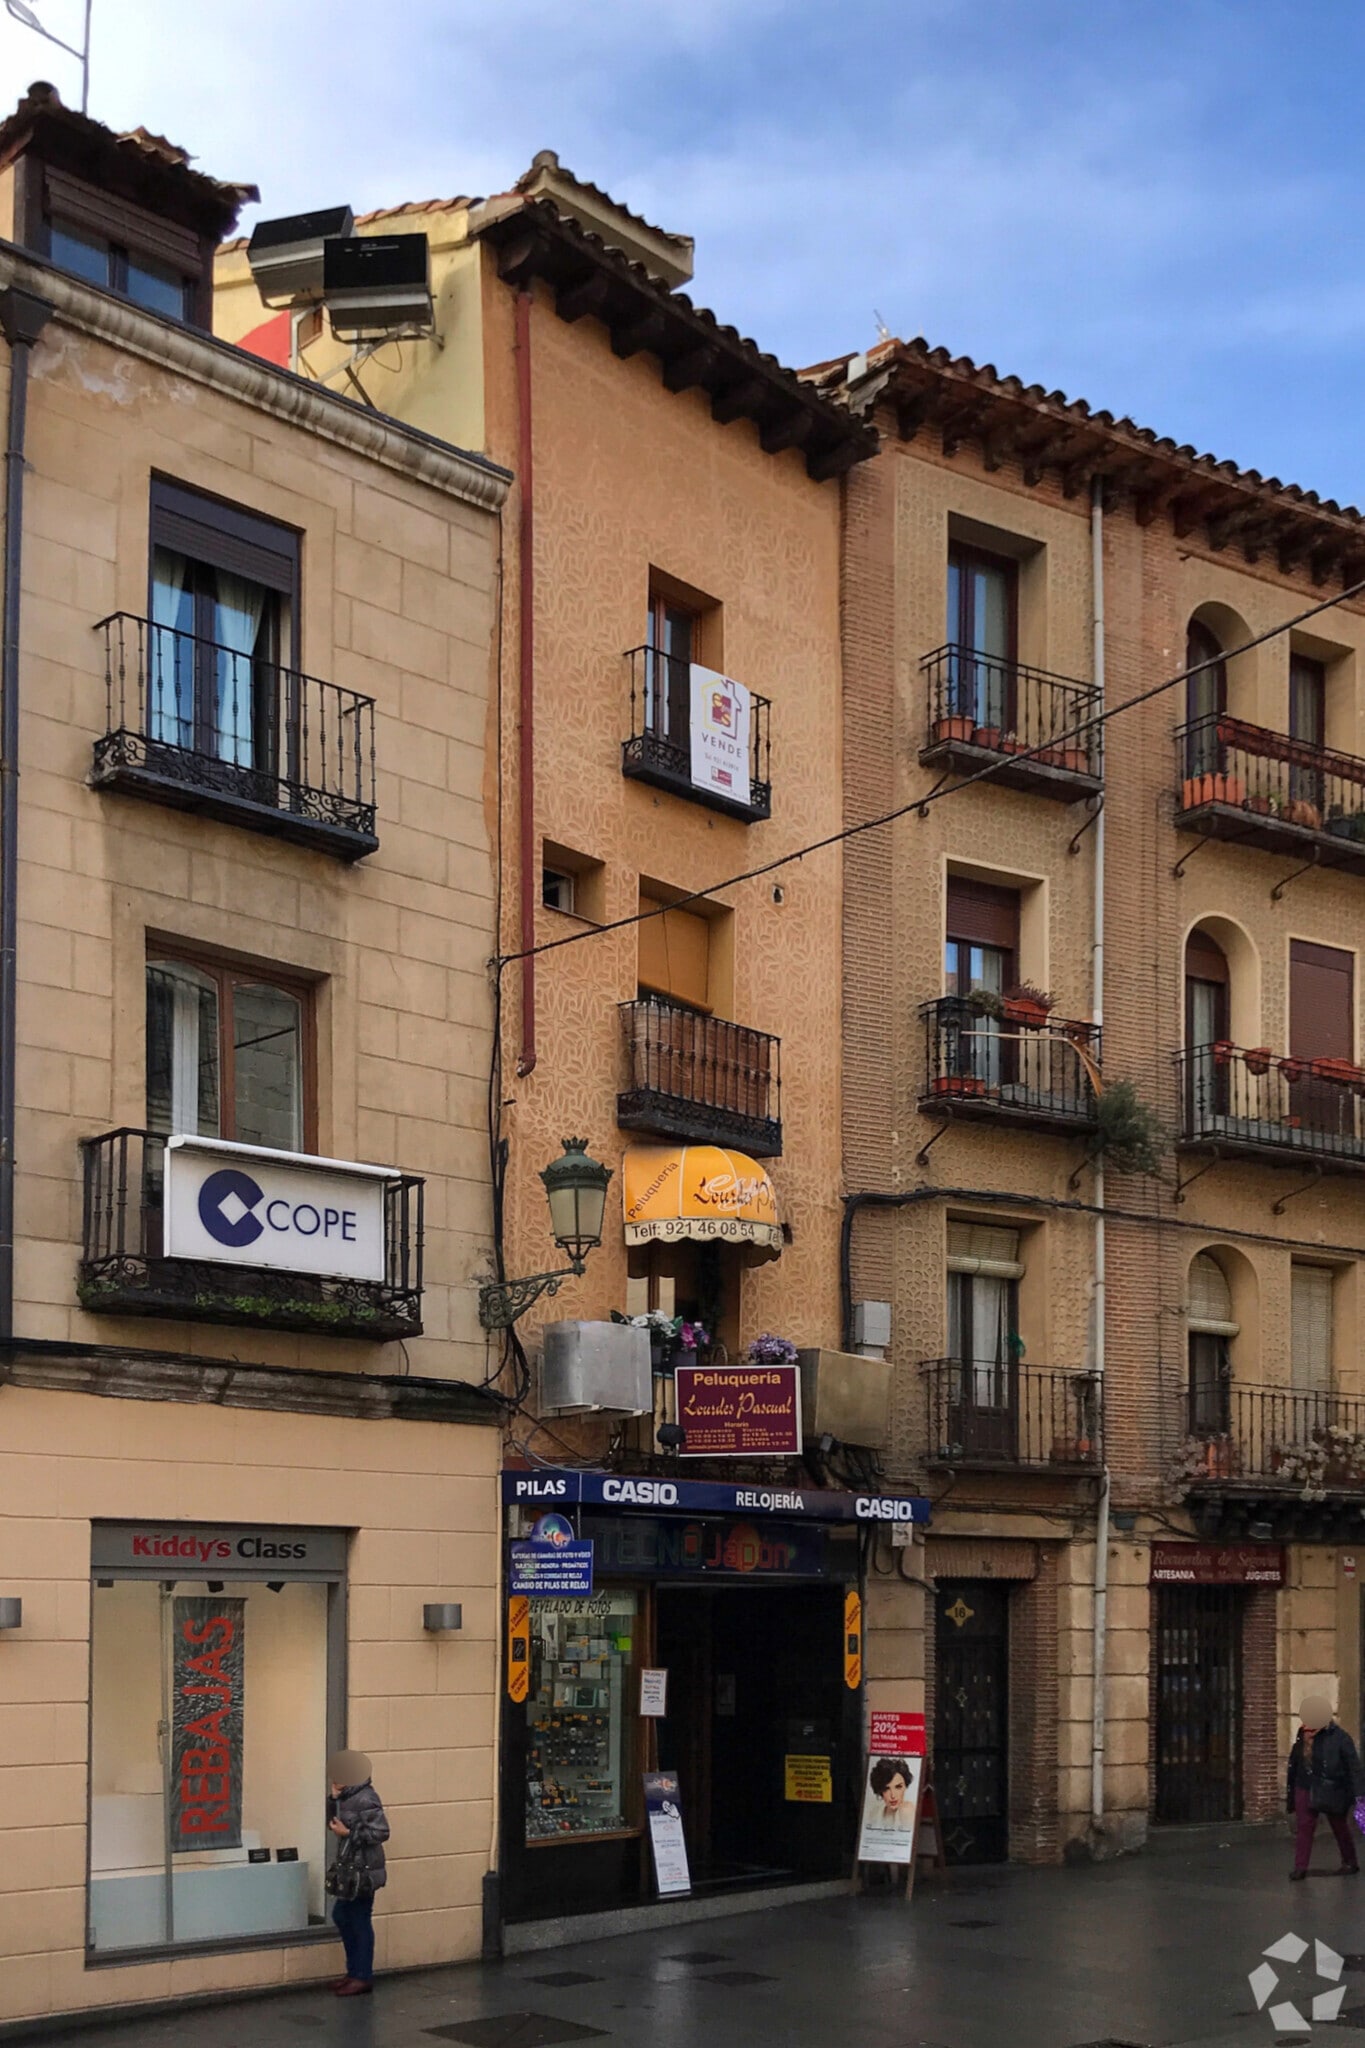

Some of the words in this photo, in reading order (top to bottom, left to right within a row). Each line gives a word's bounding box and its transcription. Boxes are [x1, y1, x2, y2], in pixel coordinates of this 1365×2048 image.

[701, 732, 742, 759] VENDE
[266, 1200, 357, 1242] COPE
[631, 1224, 661, 1239] Telf:
[665, 1221, 693, 1236] 921
[697, 1221, 717, 1235] 46
[720, 1222, 737, 1236] 08
[740, 1224, 755, 1238] 54
[693, 1371, 781, 1387] Peluquería
[684, 1394, 734, 1416] Lourdes
[736, 1392, 792, 1419] Pascual
[516, 1479, 566, 1497] PILAS
[602, 1479, 679, 1505] CASIO
[735, 1490, 804, 1512] RELOJERÍA
[855, 1498, 913, 1520] CASIO
[132, 1535, 231, 1562] Kiddy's
[237, 1537, 307, 1560] Class
[535, 1581, 544, 1590] DE
[544, 1581, 560, 1590] PILAS
[560, 1581, 569, 1590] DE
[569, 1581, 589, 1590] RELOJ
[1244, 1570, 1281, 1581] JUGUETES
[530, 1600, 572, 1614] REVELADO
[574, 1600, 585, 1614] DE
[587, 1600, 612, 1614] FOTOS
[953, 1607, 966, 1618] 16
[179, 1616, 236, 1835] REBAJAS
[872, 1721, 897, 1734] 20%
